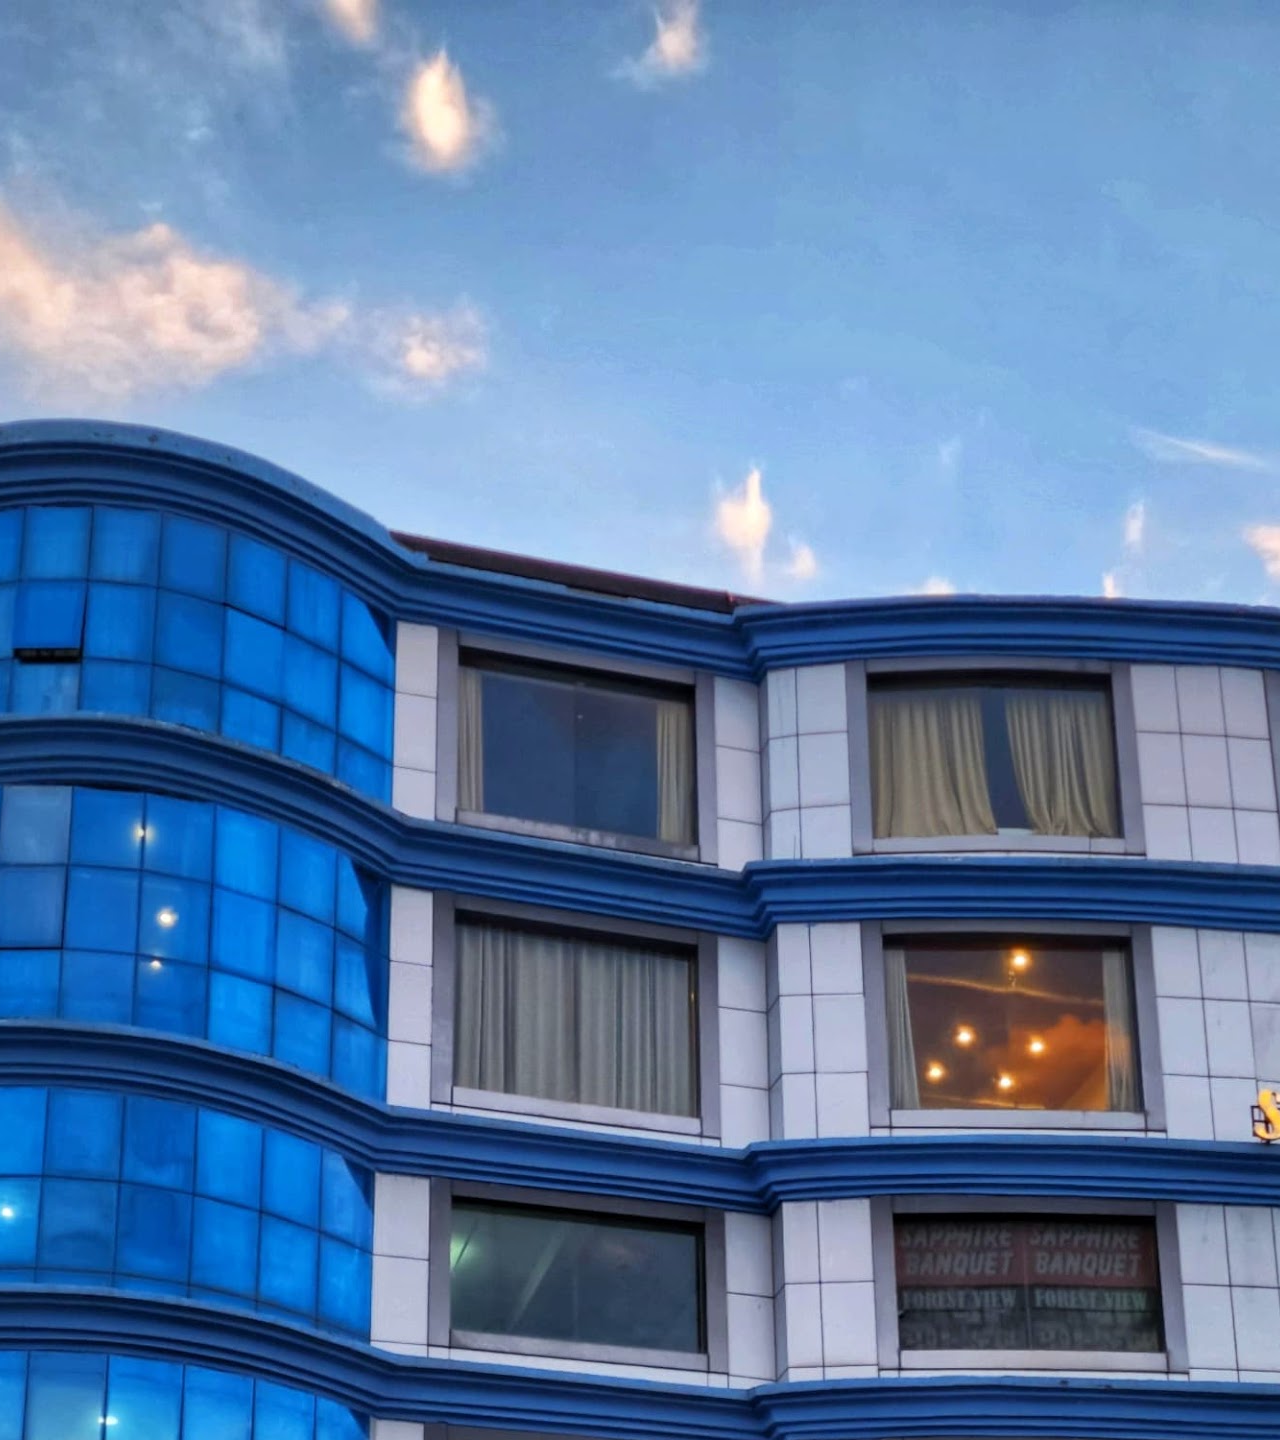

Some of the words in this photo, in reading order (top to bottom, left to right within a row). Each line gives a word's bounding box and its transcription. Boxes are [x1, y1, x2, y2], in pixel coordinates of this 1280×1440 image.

[906, 1249, 1014, 1276] BANQUET
[1034, 1251, 1143, 1279] BANQUET
[1034, 1288, 1097, 1308] FOREST
